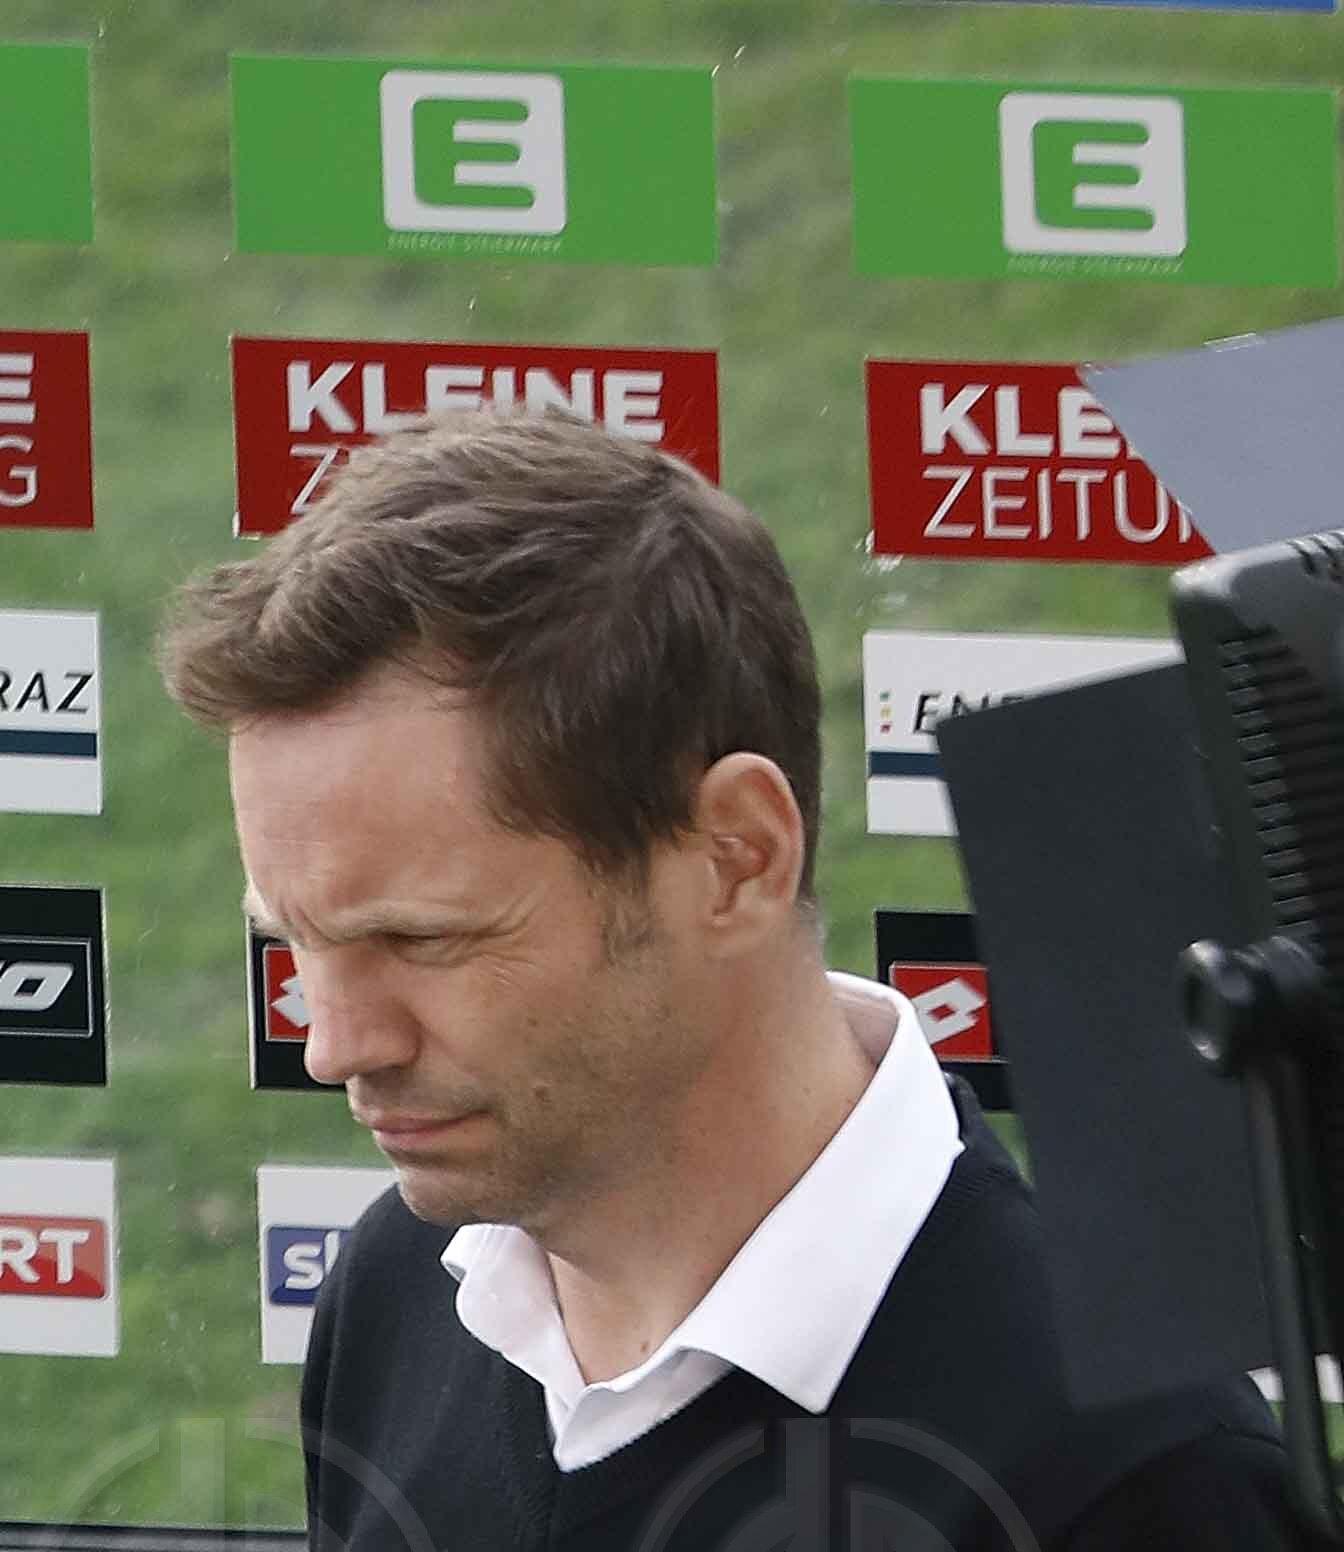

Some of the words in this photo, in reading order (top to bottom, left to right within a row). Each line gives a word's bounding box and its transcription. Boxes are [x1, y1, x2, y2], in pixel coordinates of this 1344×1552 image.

[411, 97, 536, 210] E
[1029, 118, 1156, 231] E
[919, 381, 1120, 460] KLE
[921, 464, 1194, 545] ZEITU
